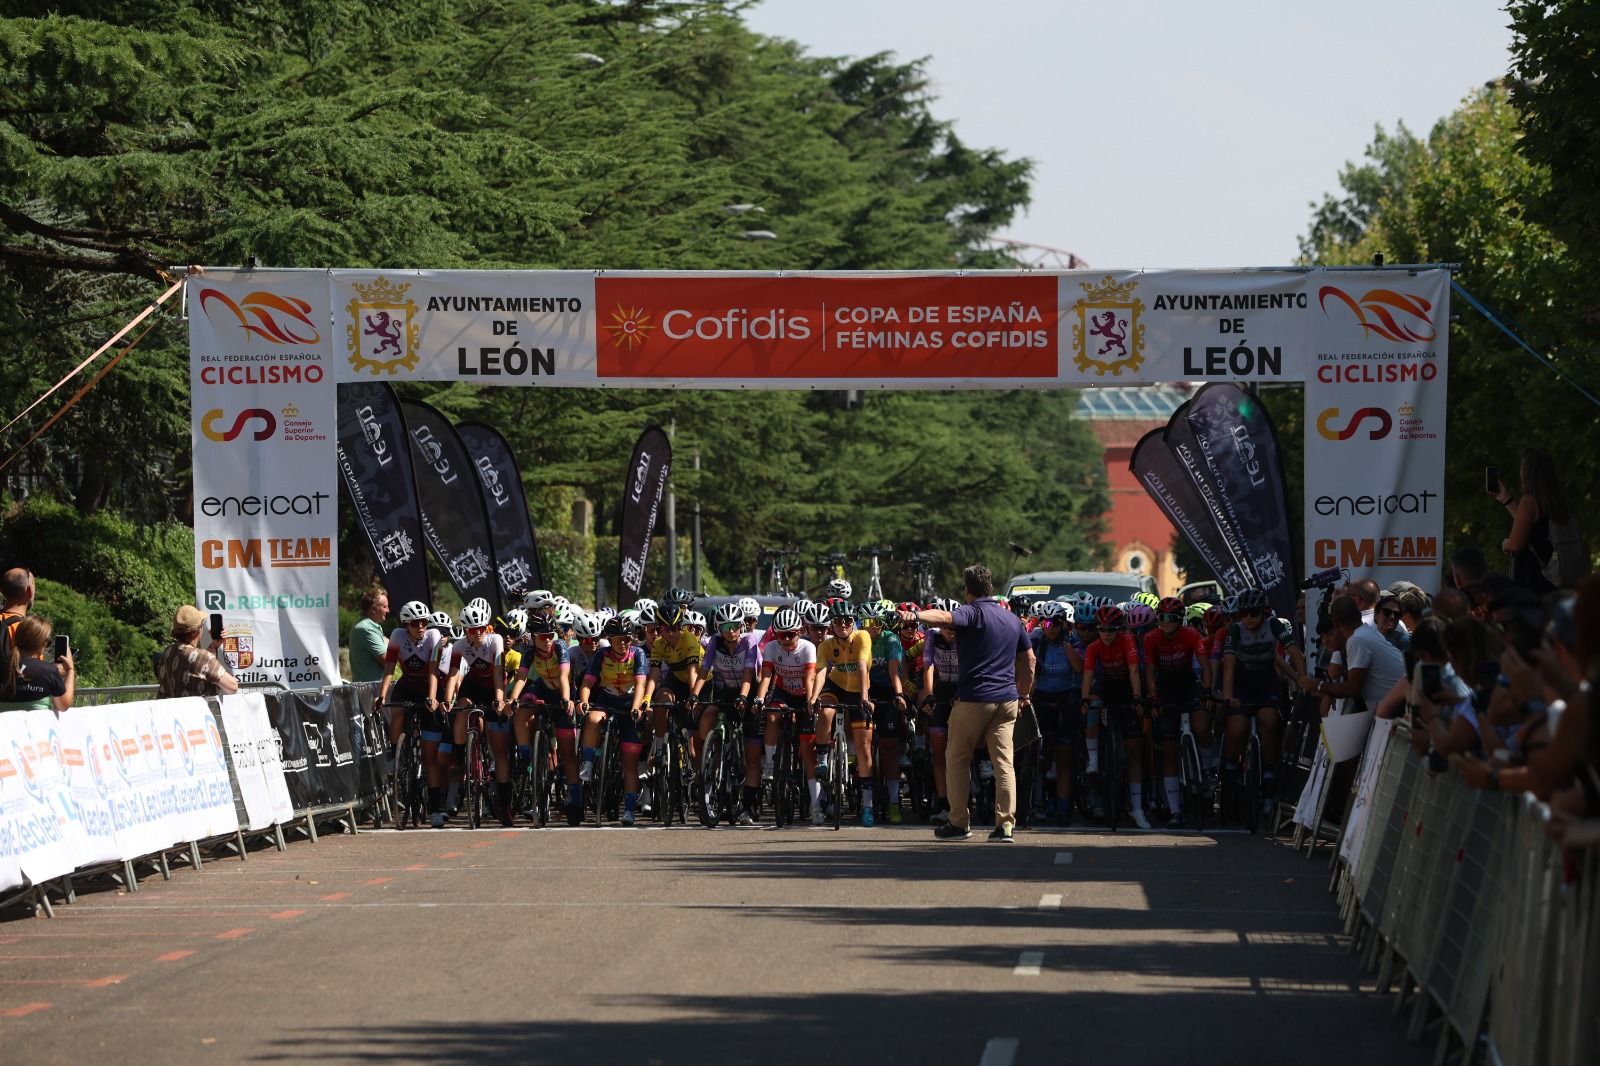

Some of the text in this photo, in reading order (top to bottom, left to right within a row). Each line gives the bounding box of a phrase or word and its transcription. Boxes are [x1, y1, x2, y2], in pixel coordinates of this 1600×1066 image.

[427, 296, 582, 313] AYUNTAMIENTO
[1153, 293, 1307, 310] AYUNTAMIENTO
[834, 300, 1042, 324] COPA DE ESPAÑA
[492, 320, 518, 336] DE
[662, 308, 811, 340] Cofidis
[1219, 318, 1244, 334] DE
[836, 326, 1048, 348] FÉMINAS COFIDIS
[224, 353, 276, 362] FEDERACIÓN
[279, 352, 322, 361] ESPAÑOLA
[458, 342, 555, 376] LEÓN
[1184, 340, 1282, 376] LEÓN
[1341, 352, 1394, 360] FEDERACIÓN
[1398, 350, 1436, 359] ESPAÑOLA
[201, 365, 323, 384] CICLISMO
[1318, 362, 1437, 384] CICLISMO
[201, 491, 330, 516] eneicat
[1314, 490, 1437, 516] eneicat
[202, 537, 330, 569] CM TEAM
[1314, 536, 1437, 568] CM TEAM
[238, 592, 330, 610] RBHGlobal
[256, 654, 320, 668] Junta de
[236, 671, 268, 682] stilla
[288, 669, 320, 682] León
